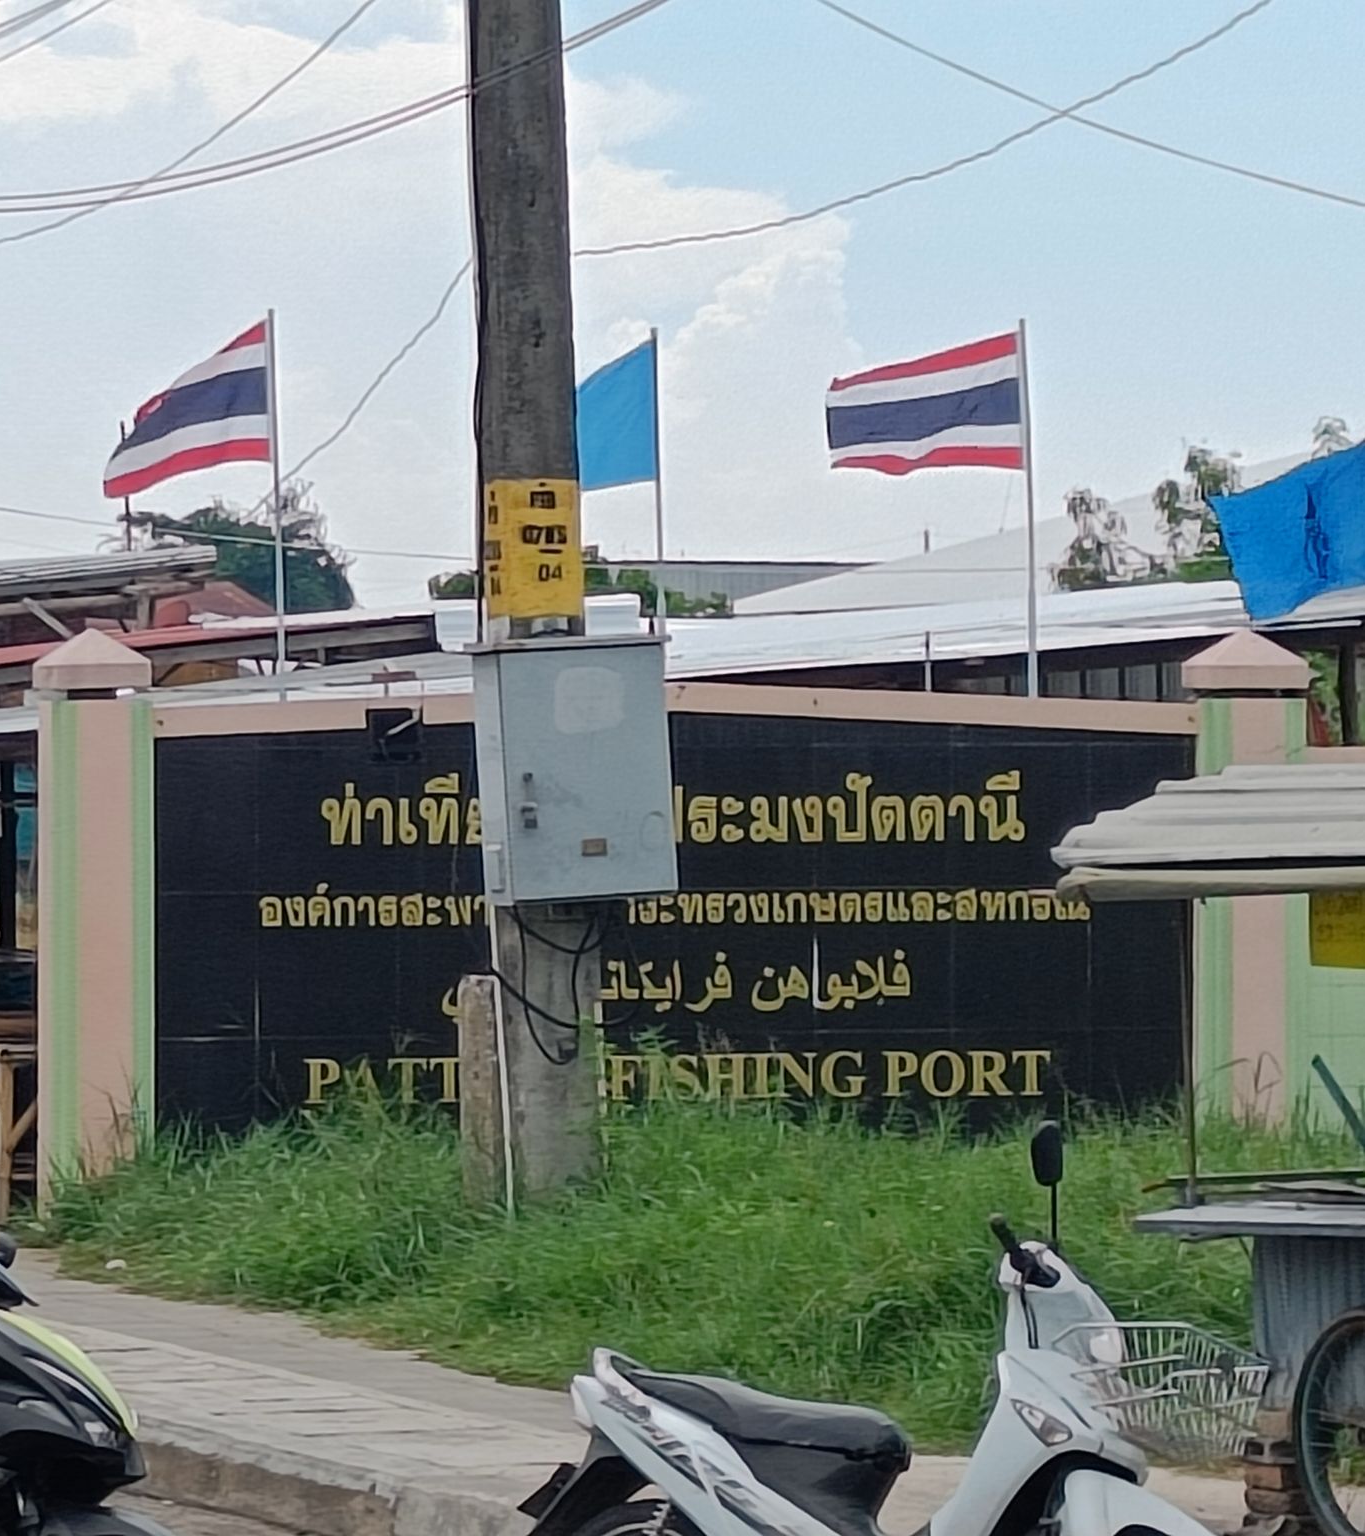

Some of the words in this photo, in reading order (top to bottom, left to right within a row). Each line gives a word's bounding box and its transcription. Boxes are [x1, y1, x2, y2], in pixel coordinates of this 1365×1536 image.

[538, 563, 563, 582] 04
[673, 769, 1026, 843] ระมงปัตตานี
[880, 1048, 1052, 1099] PORT
